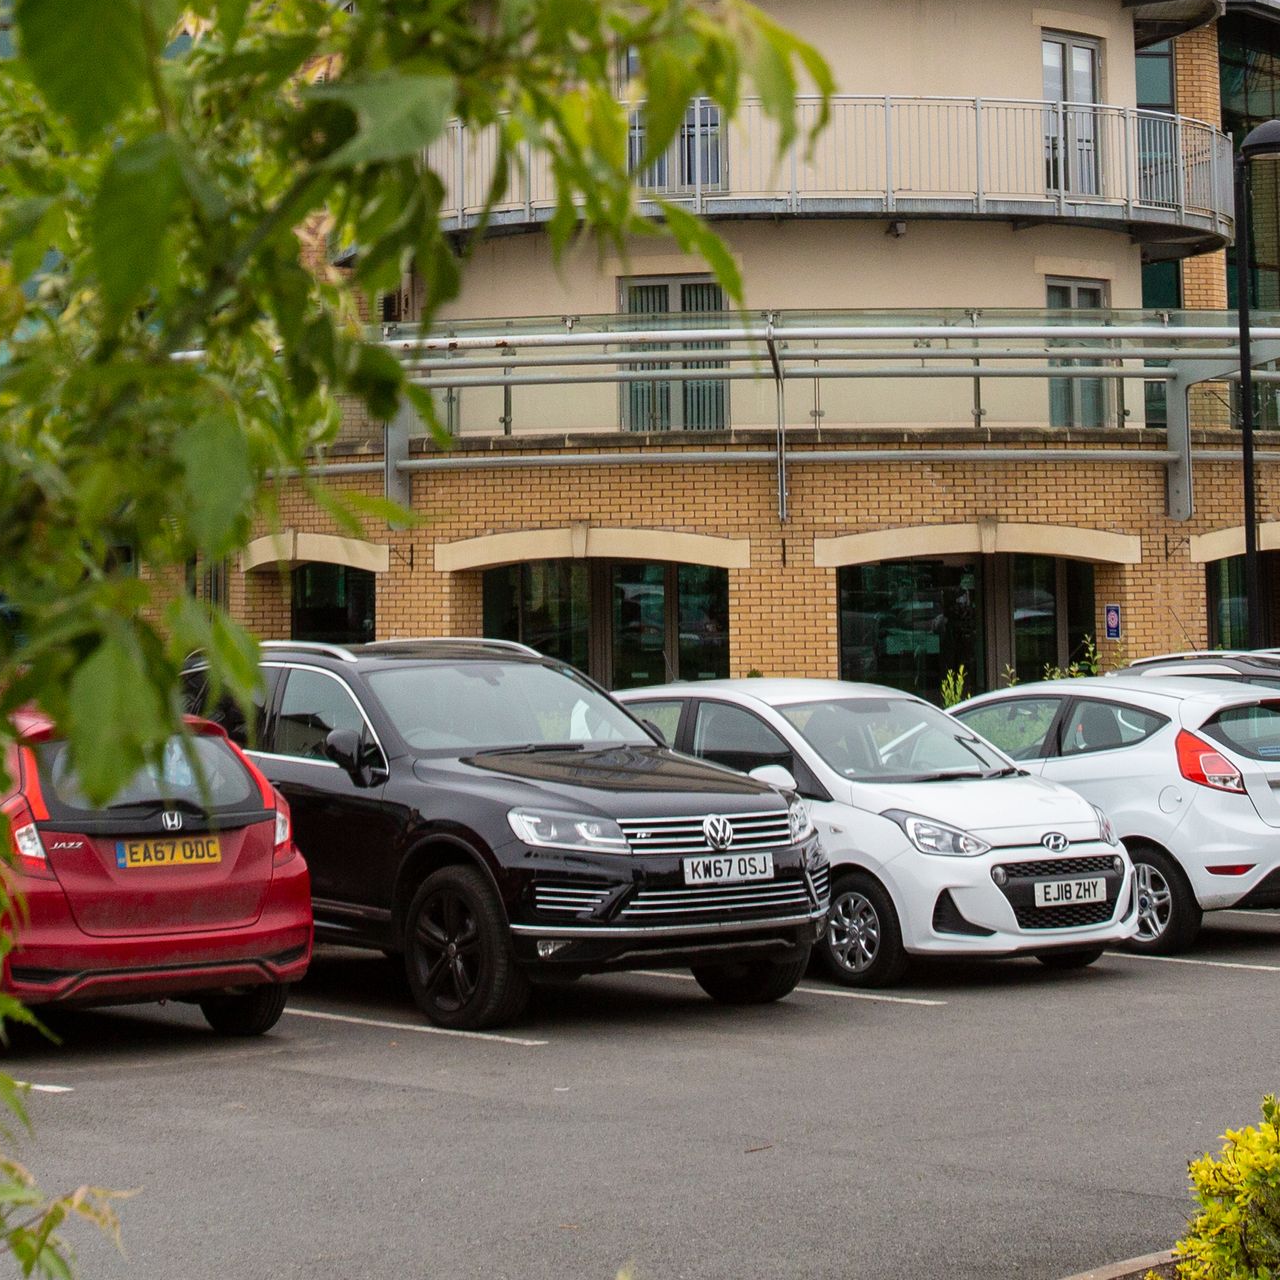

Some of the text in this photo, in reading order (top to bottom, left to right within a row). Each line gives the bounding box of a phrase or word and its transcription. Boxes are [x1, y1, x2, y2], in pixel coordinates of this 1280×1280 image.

[49, 841, 84, 850] JAZZ
[128, 839, 218, 863] EA67 ODC
[691, 856, 767, 880] KW67 OSJ
[1043, 881, 1098, 902] EJ18 ZHY
